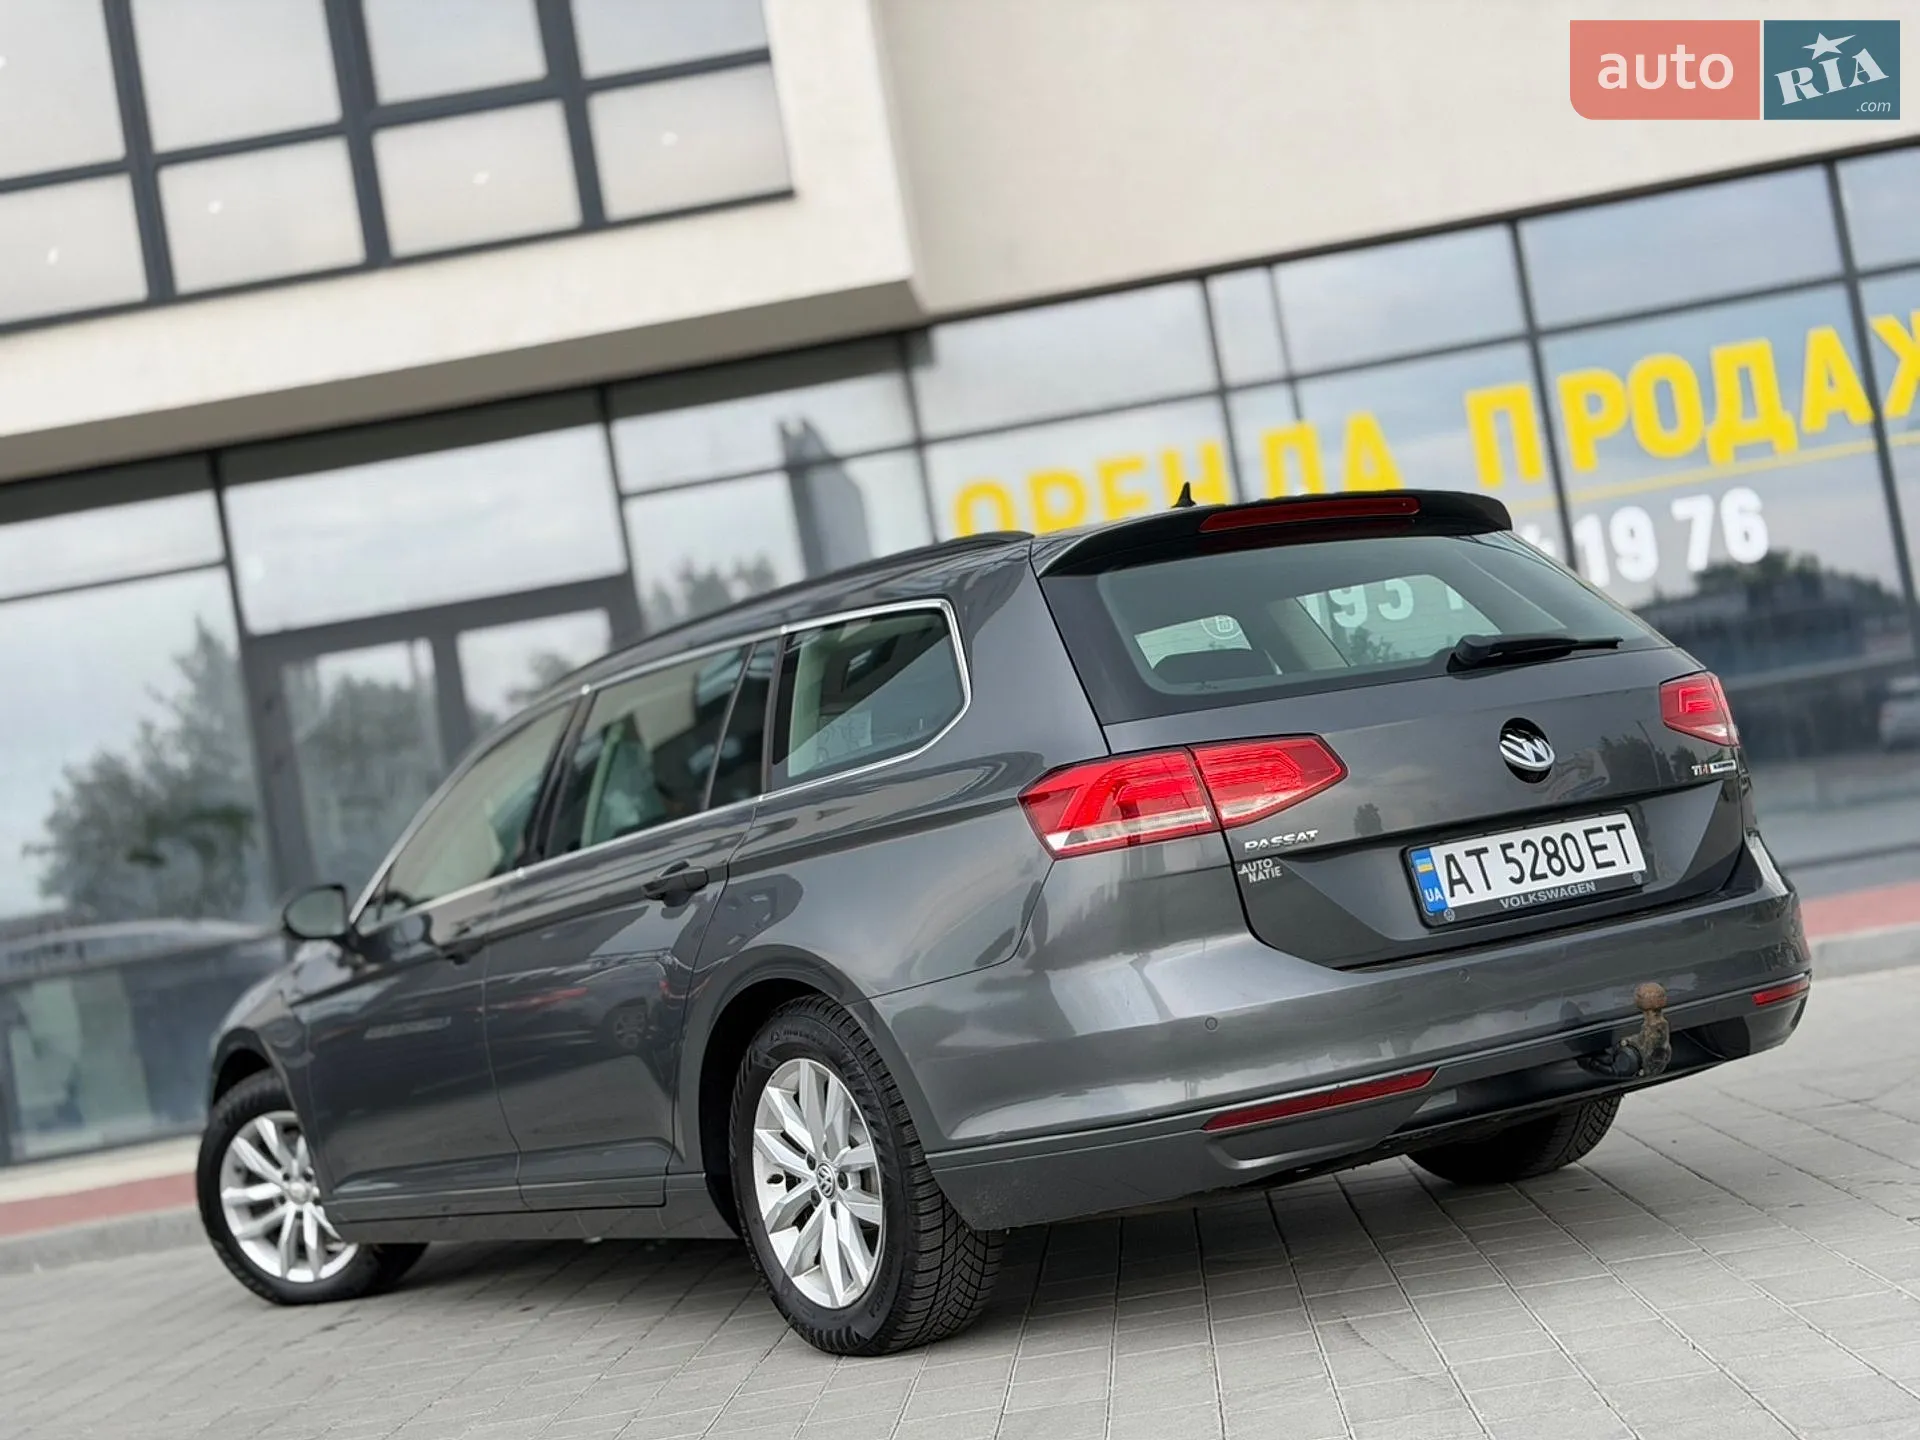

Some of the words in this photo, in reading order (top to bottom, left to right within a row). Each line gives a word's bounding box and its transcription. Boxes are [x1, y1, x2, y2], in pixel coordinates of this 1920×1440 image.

[1573, 505, 1659, 587] 19
[1671, 487, 1769, 571] 76
[1244, 829, 1319, 852] PASSAT
[1238, 858, 1273, 875] AUTO
[1444, 846, 1492, 898] AT
[1499, 832, 1586, 885] 5280
[1583, 823, 1631, 870] ET
[1248, 866, 1283, 883] NATIE
[1424, 888, 1444, 902] UA
[1500, 881, 1597, 909] VOLKSWAGEN
